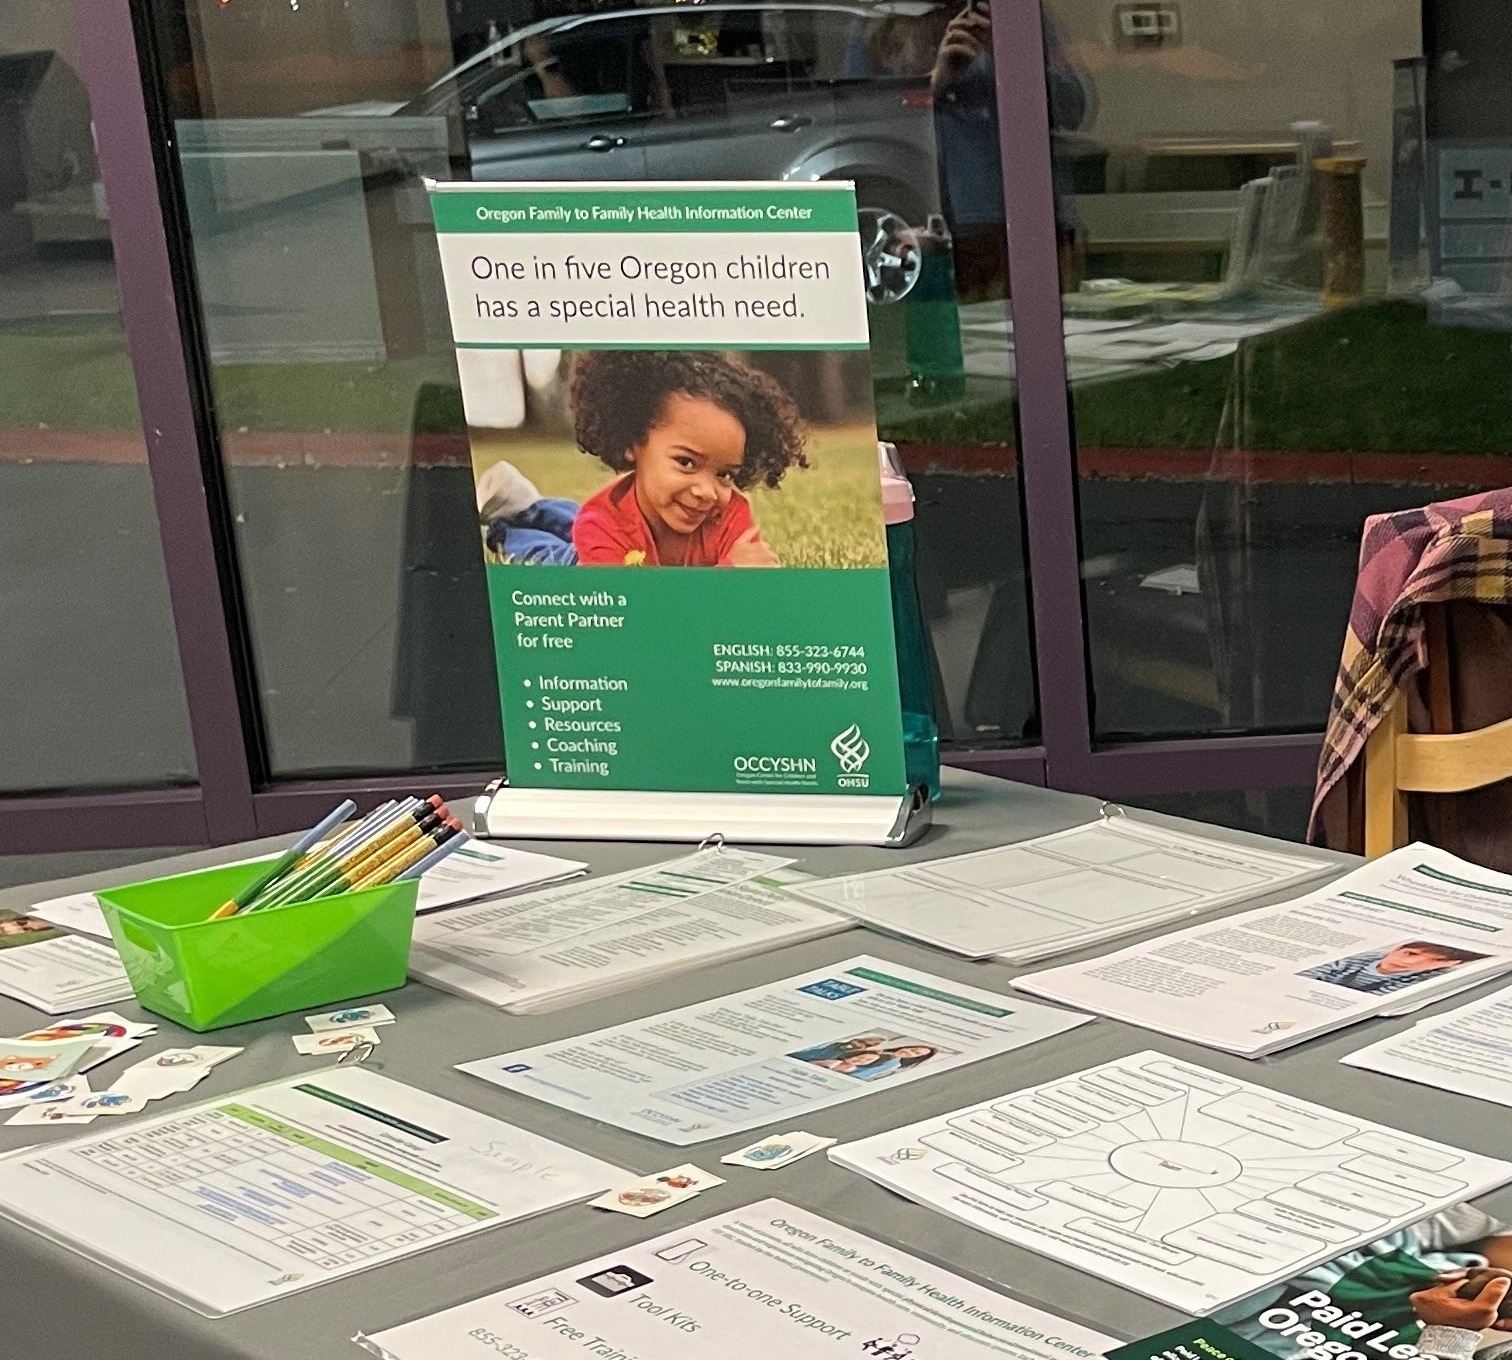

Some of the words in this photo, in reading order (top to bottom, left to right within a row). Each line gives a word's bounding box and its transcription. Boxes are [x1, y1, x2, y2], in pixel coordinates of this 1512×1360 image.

[476, 206, 526, 223] Oregon
[529, 206, 571, 223] Family
[575, 207, 589, 220] to
[592, 206, 634, 223] Family
[637, 205, 682, 220] Health
[685, 205, 764, 220] Information
[767, 205, 813, 220] Center
[471, 255, 526, 280] One
[534, 257, 556, 279] in
[565, 254, 612, 279] five
[620, 255, 717, 287] Oregon
[726, 255, 830, 280] children
[477, 295, 518, 318] has
[527, 300, 541, 318] a
[550, 293, 636, 323] special
[645, 294, 725, 317] health
[735, 295, 805, 317] need.
[512, 591, 576, 607] Connect
[579, 592, 613, 607] with
[618, 595, 626, 606] a
[515, 614, 565, 627] Parent
[568, 614, 624, 627] Partner
[517, 634, 538, 648] for
[543, 635, 573, 648] free
[713, 644, 773, 657] ENGLISH:
[776, 645, 865, 658] 855-323-6744
[716, 661, 775, 674] SPANISH:
[778, 662, 866, 674] 833-990-9930
[539, 676, 628, 690] Information
[542, 697, 602, 713] Support
[545, 718, 621, 732] Resources
[547, 738, 617, 755] Coaching
[549, 759, 608, 775] Training
[734, 757, 816, 772] OCCYSHN
[838, 778, 869, 787] OHSU
[770, 1218, 818, 1242] Oregon
[817, 1236, 858, 1261] Family
[858, 1256, 875, 1268] to
[873, 1262, 920, 1288] Family
[916, 1283, 965, 1311] Health
[962, 1306, 1043, 1342] Information
[1043, 1335, 1095, 1359] Center
[689, 1260, 783, 1309] One-to-one
[779, 1302, 852, 1341] Support
[629, 1294, 663, 1318] Tool
[665, 1313, 701, 1334] Kits
[1289, 1290, 1383, 1339] Paid
[543, 1315, 585, 1341] Free
